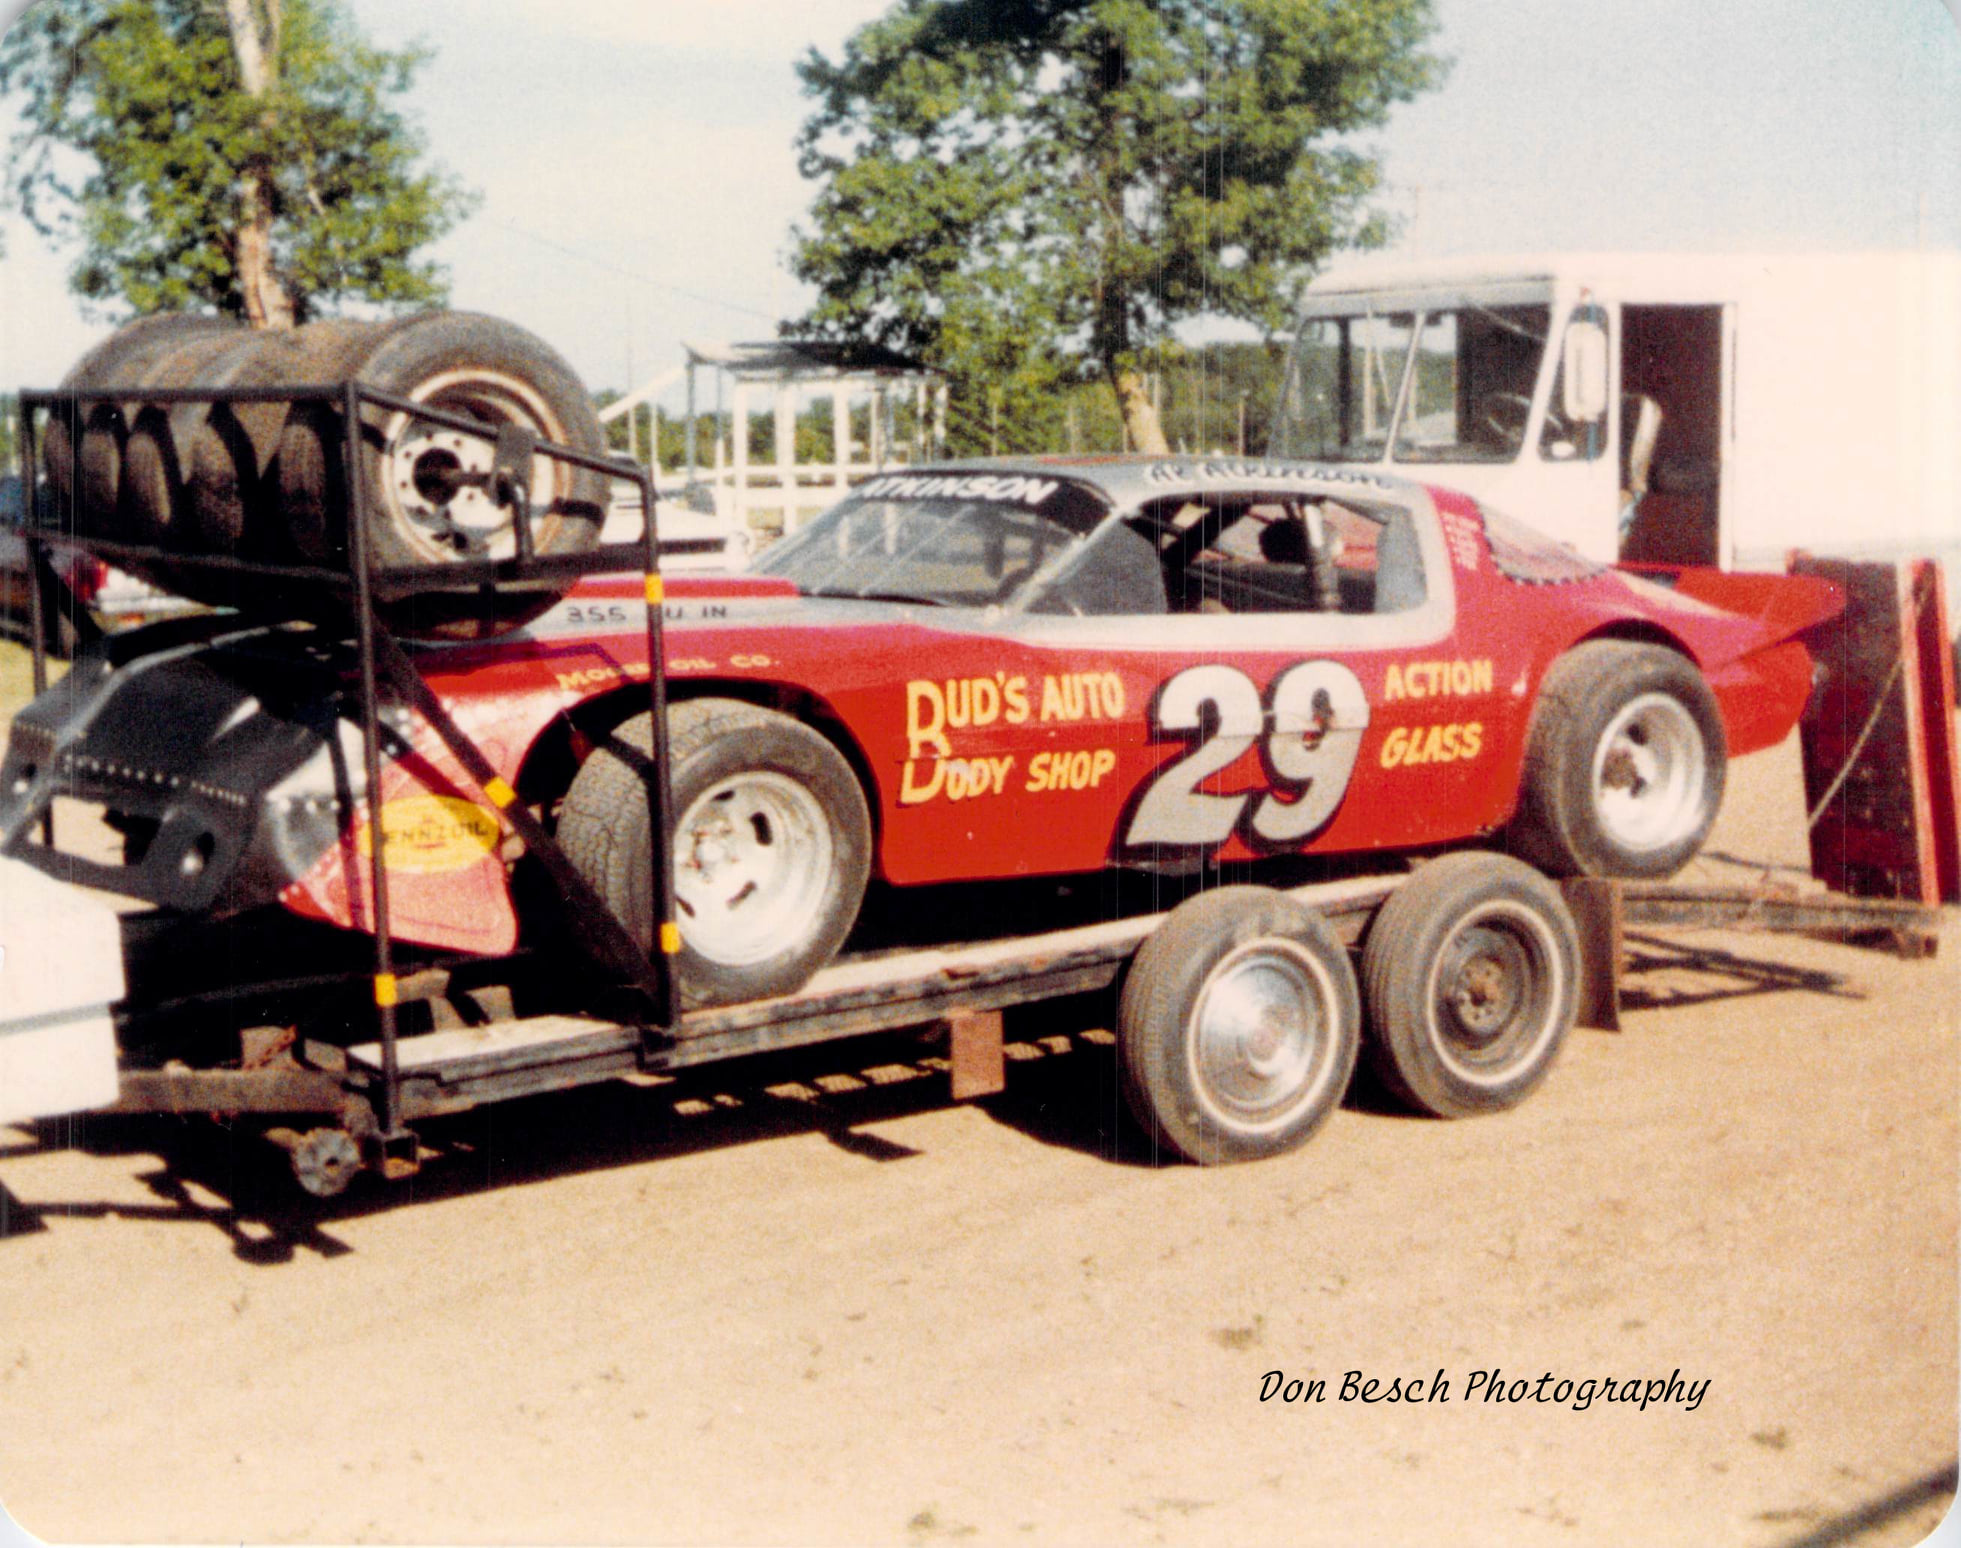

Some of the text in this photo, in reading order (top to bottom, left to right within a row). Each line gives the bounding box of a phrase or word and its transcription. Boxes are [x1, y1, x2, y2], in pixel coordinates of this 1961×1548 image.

[567, 606, 626, 622] 355
[703, 605, 727, 618] IN
[1384, 659, 1494, 701] ACTION
[906, 671, 1125, 757] BUD'S AUTO
[1116, 657, 1371, 850] 29
[1380, 722, 1484, 769] GLASS
[1025, 749, 1116, 792] SHOP
[383, 821, 488, 841] ENNZOIL
